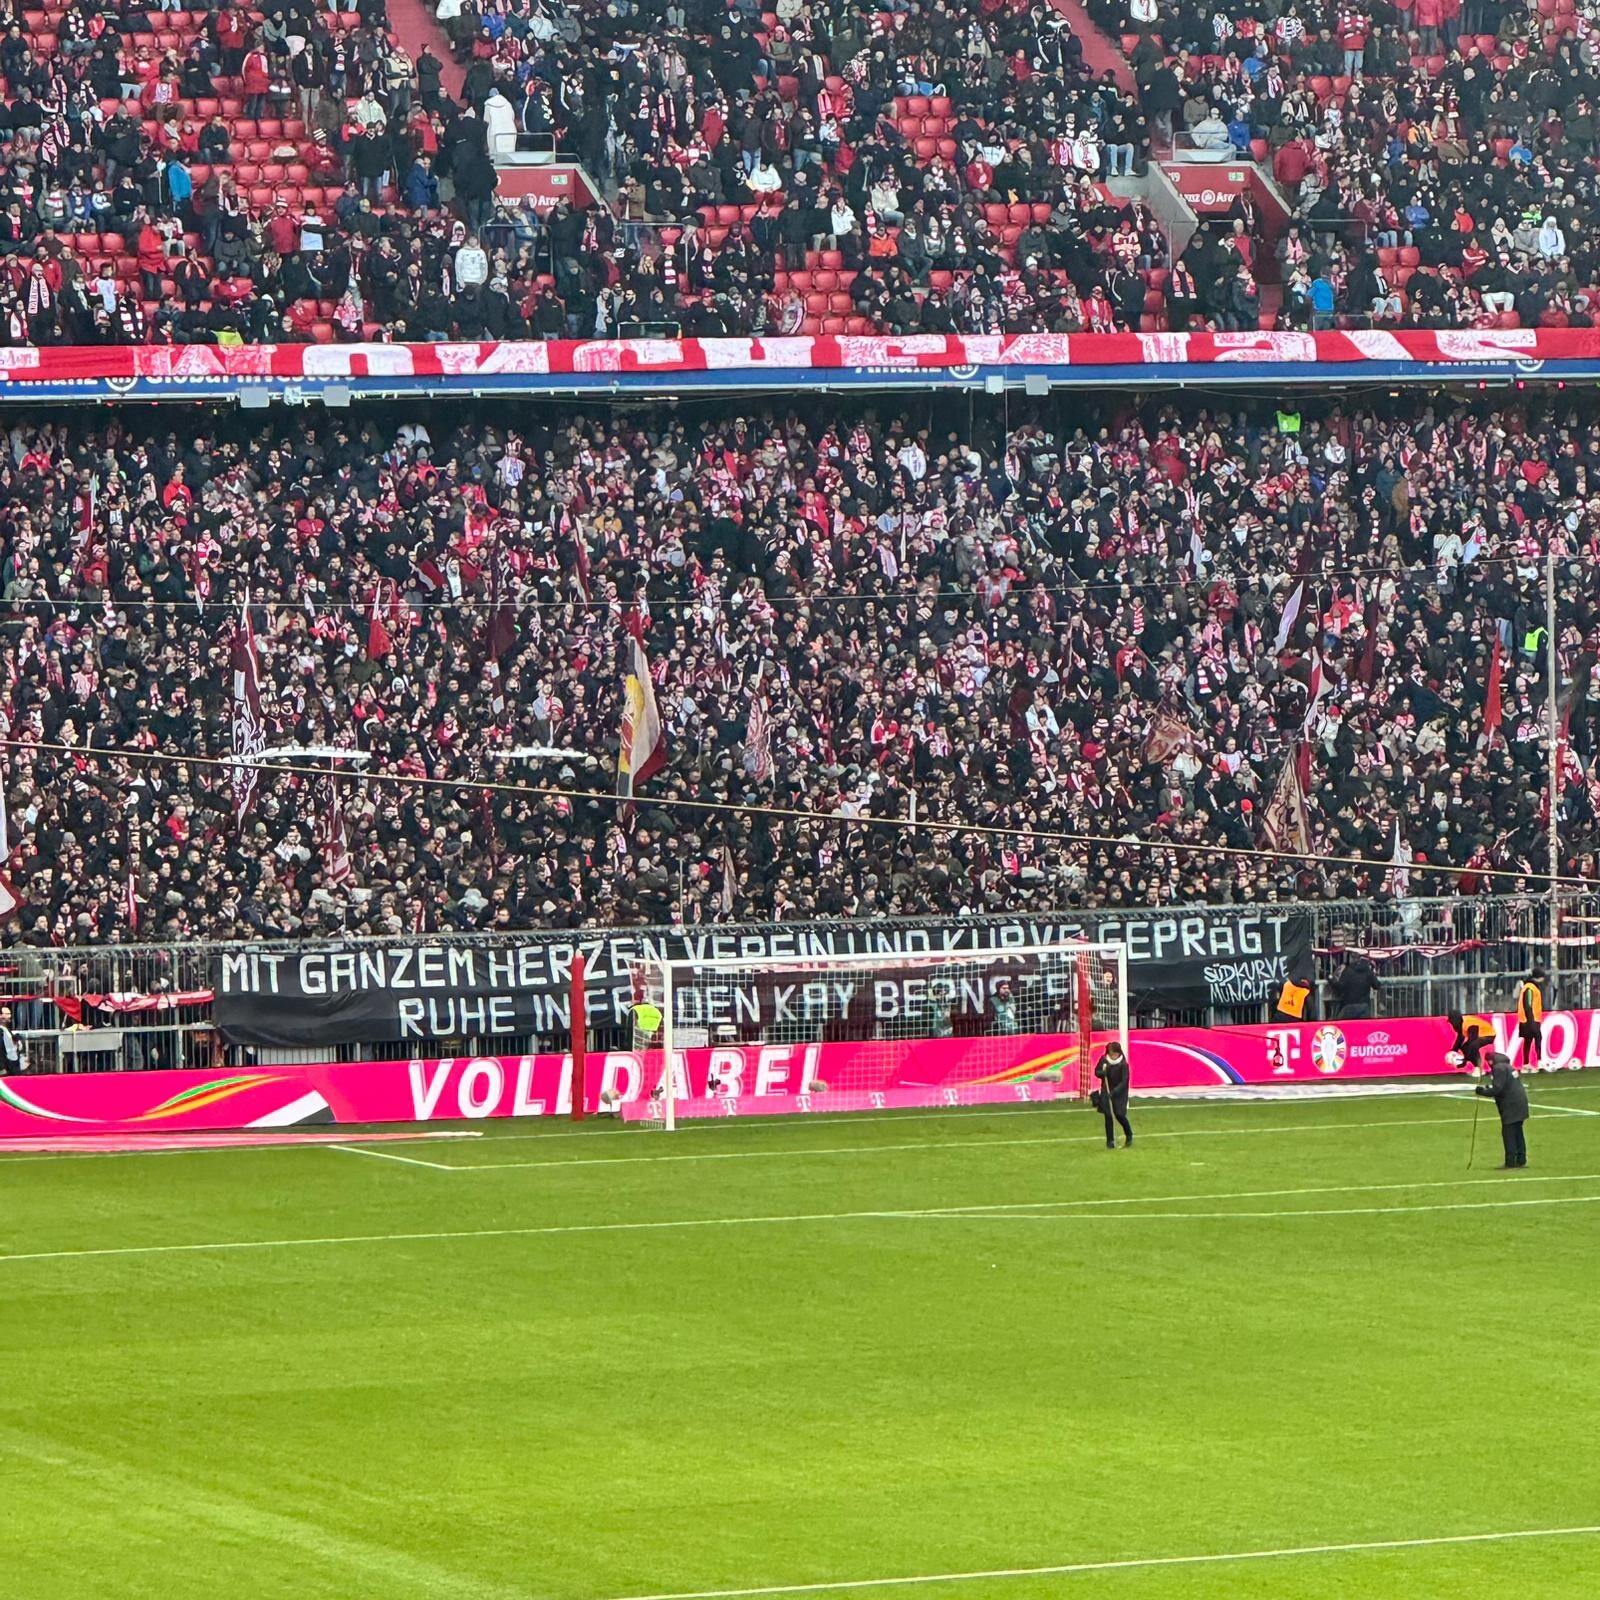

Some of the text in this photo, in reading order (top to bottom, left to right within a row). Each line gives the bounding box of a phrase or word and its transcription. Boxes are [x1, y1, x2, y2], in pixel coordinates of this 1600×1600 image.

[222, 916, 1289, 994] MIT GANZEM HERZEN VEREIN UND KURVE GEPRÄGT
[399, 995, 515, 1037] RUHE
[533, 993, 571, 1031] IN
[774, 982, 856, 1022] KAY
